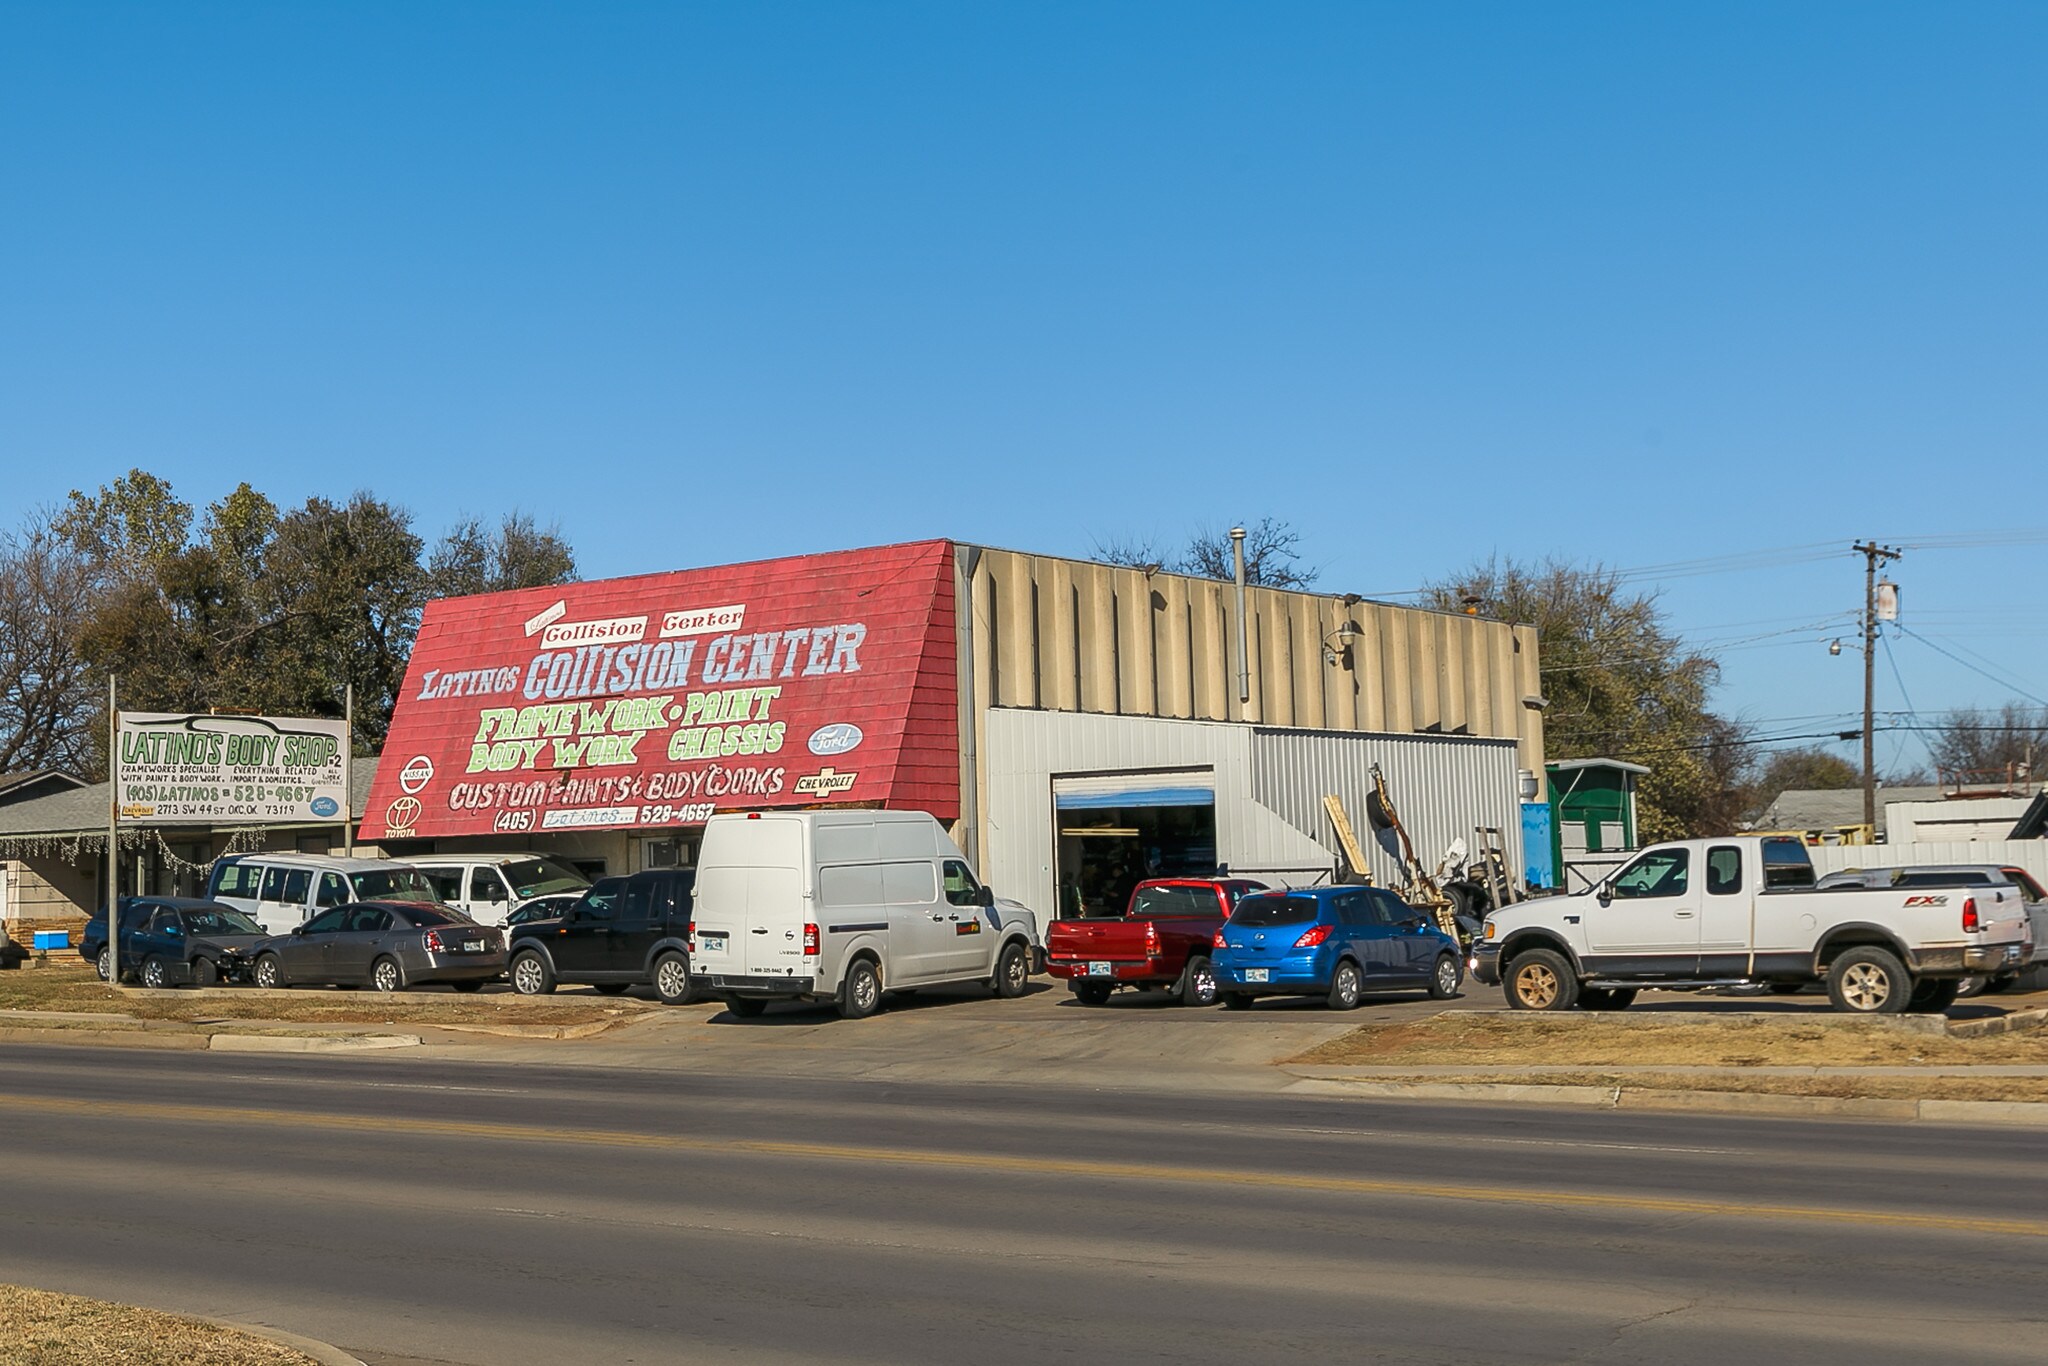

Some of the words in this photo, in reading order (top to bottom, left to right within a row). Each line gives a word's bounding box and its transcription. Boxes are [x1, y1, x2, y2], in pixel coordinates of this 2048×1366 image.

[702, 622, 868, 684] CENTER
[681, 685, 782, 727] PAINT
[465, 740, 547, 773] BODY
[553, 730, 646, 768] WORK
[667, 721, 787, 761] CHASSIS
[816, 729, 850, 751] Ford
[225, 734, 280, 766] BODY
[282, 736, 339, 768] SHOP
[121, 765, 177, 774] FRAMEWORKS
[179, 765, 220, 774] SPECIALIST
[233, 766, 280, 776] EVERYTHING
[284, 767, 318, 776] RELATED
[403, 769, 431, 779] NISSAN
[121, 774, 142, 782] WITH
[145, 774, 169, 782] PAINT
[179, 775, 199, 783] BODY
[229, 775, 256, 784] IMPORT
[798, 775, 852, 790] CHEVROLET
[126, 784, 158, 802] (405)
[159, 786, 219, 802] LATINOS
[233, 785, 316, 802] 528-4667
[449, 780, 547, 815] CUSTOM
[644, 771, 707, 801] BODY
[704, 763, 786, 799] WORKS
[157, 804, 178, 815] 2713
[182, 804, 197, 815] SW
[265, 804, 295, 815] 73119
[493, 809, 537, 832] (405)
[640, 803, 716, 823] 528-4667
[385, 829, 416, 838] TOYOTA
